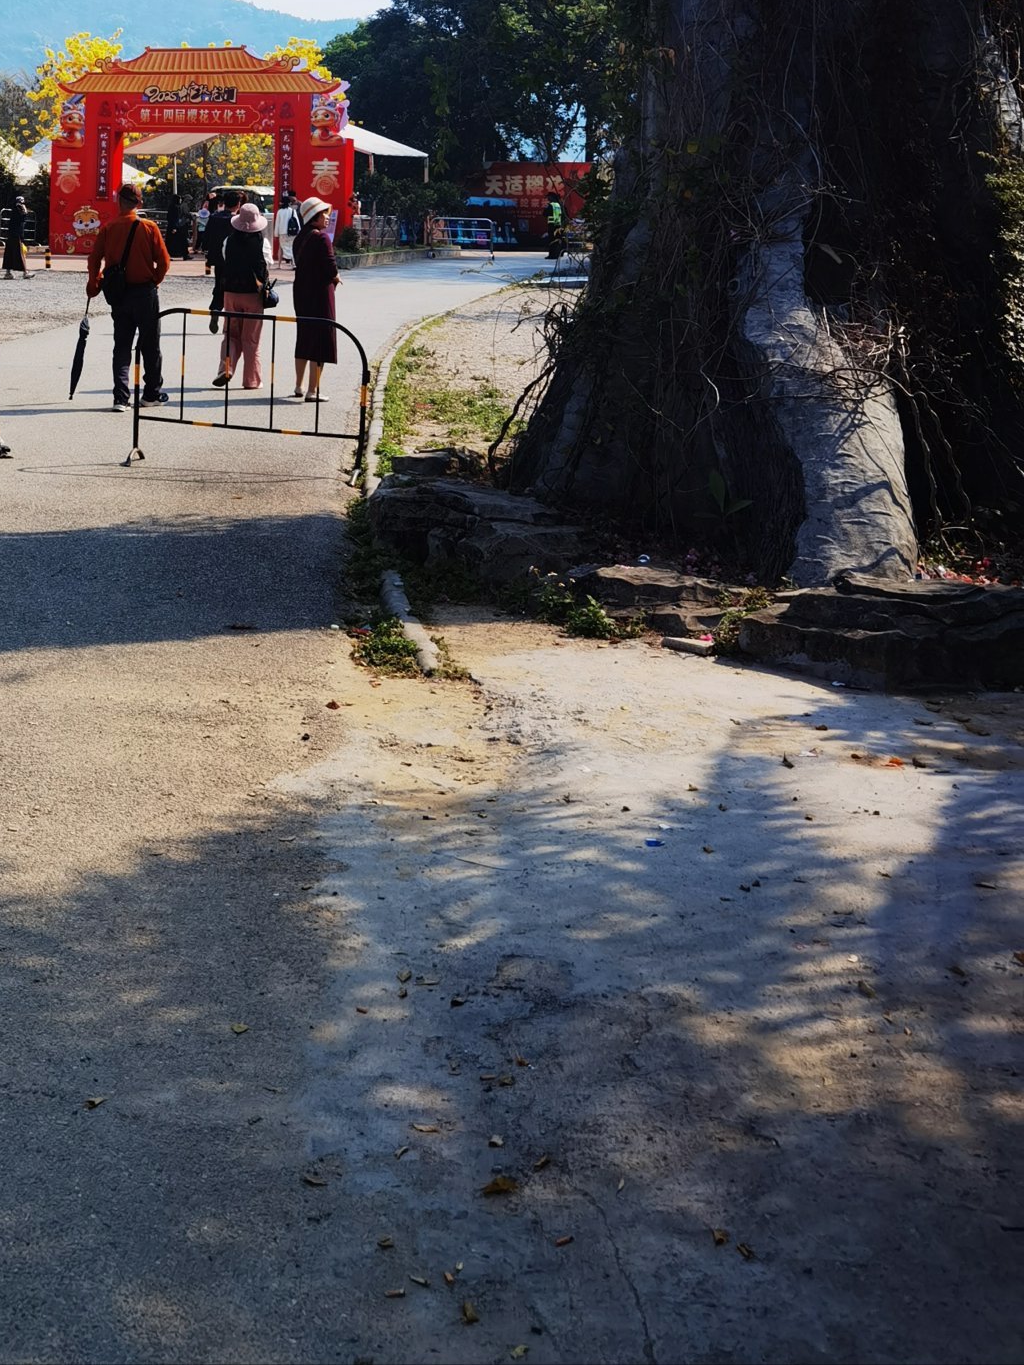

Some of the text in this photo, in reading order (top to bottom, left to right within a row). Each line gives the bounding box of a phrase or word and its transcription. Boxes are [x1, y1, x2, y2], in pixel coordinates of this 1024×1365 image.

[139, 108, 247, 124] 第十四届樱花文化节
